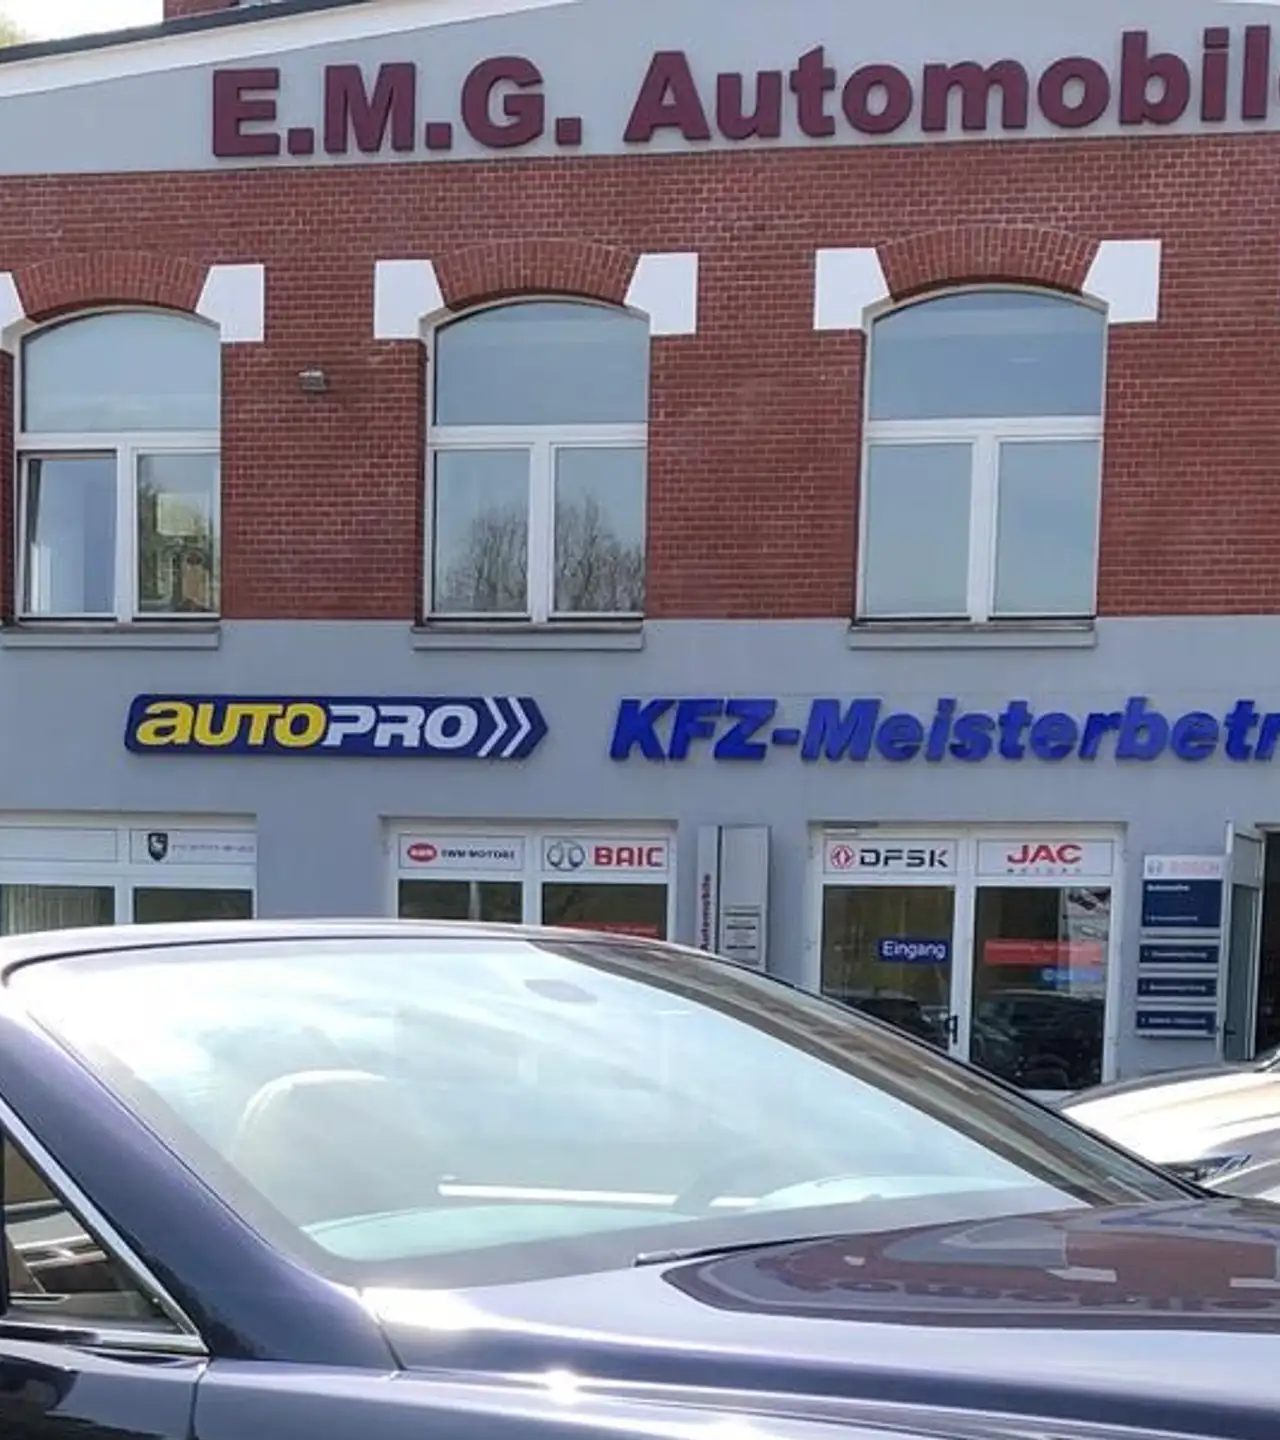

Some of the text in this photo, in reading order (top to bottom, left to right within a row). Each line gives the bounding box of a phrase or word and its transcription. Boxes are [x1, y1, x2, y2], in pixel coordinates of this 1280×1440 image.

[211, 56, 582, 157] E.M.G.
[594, 845, 664, 868] BAIC
[859, 848, 949, 869] DFSK
[1007, 844, 1083, 865] JAC
[881, 940, 947, 960] Eingang
